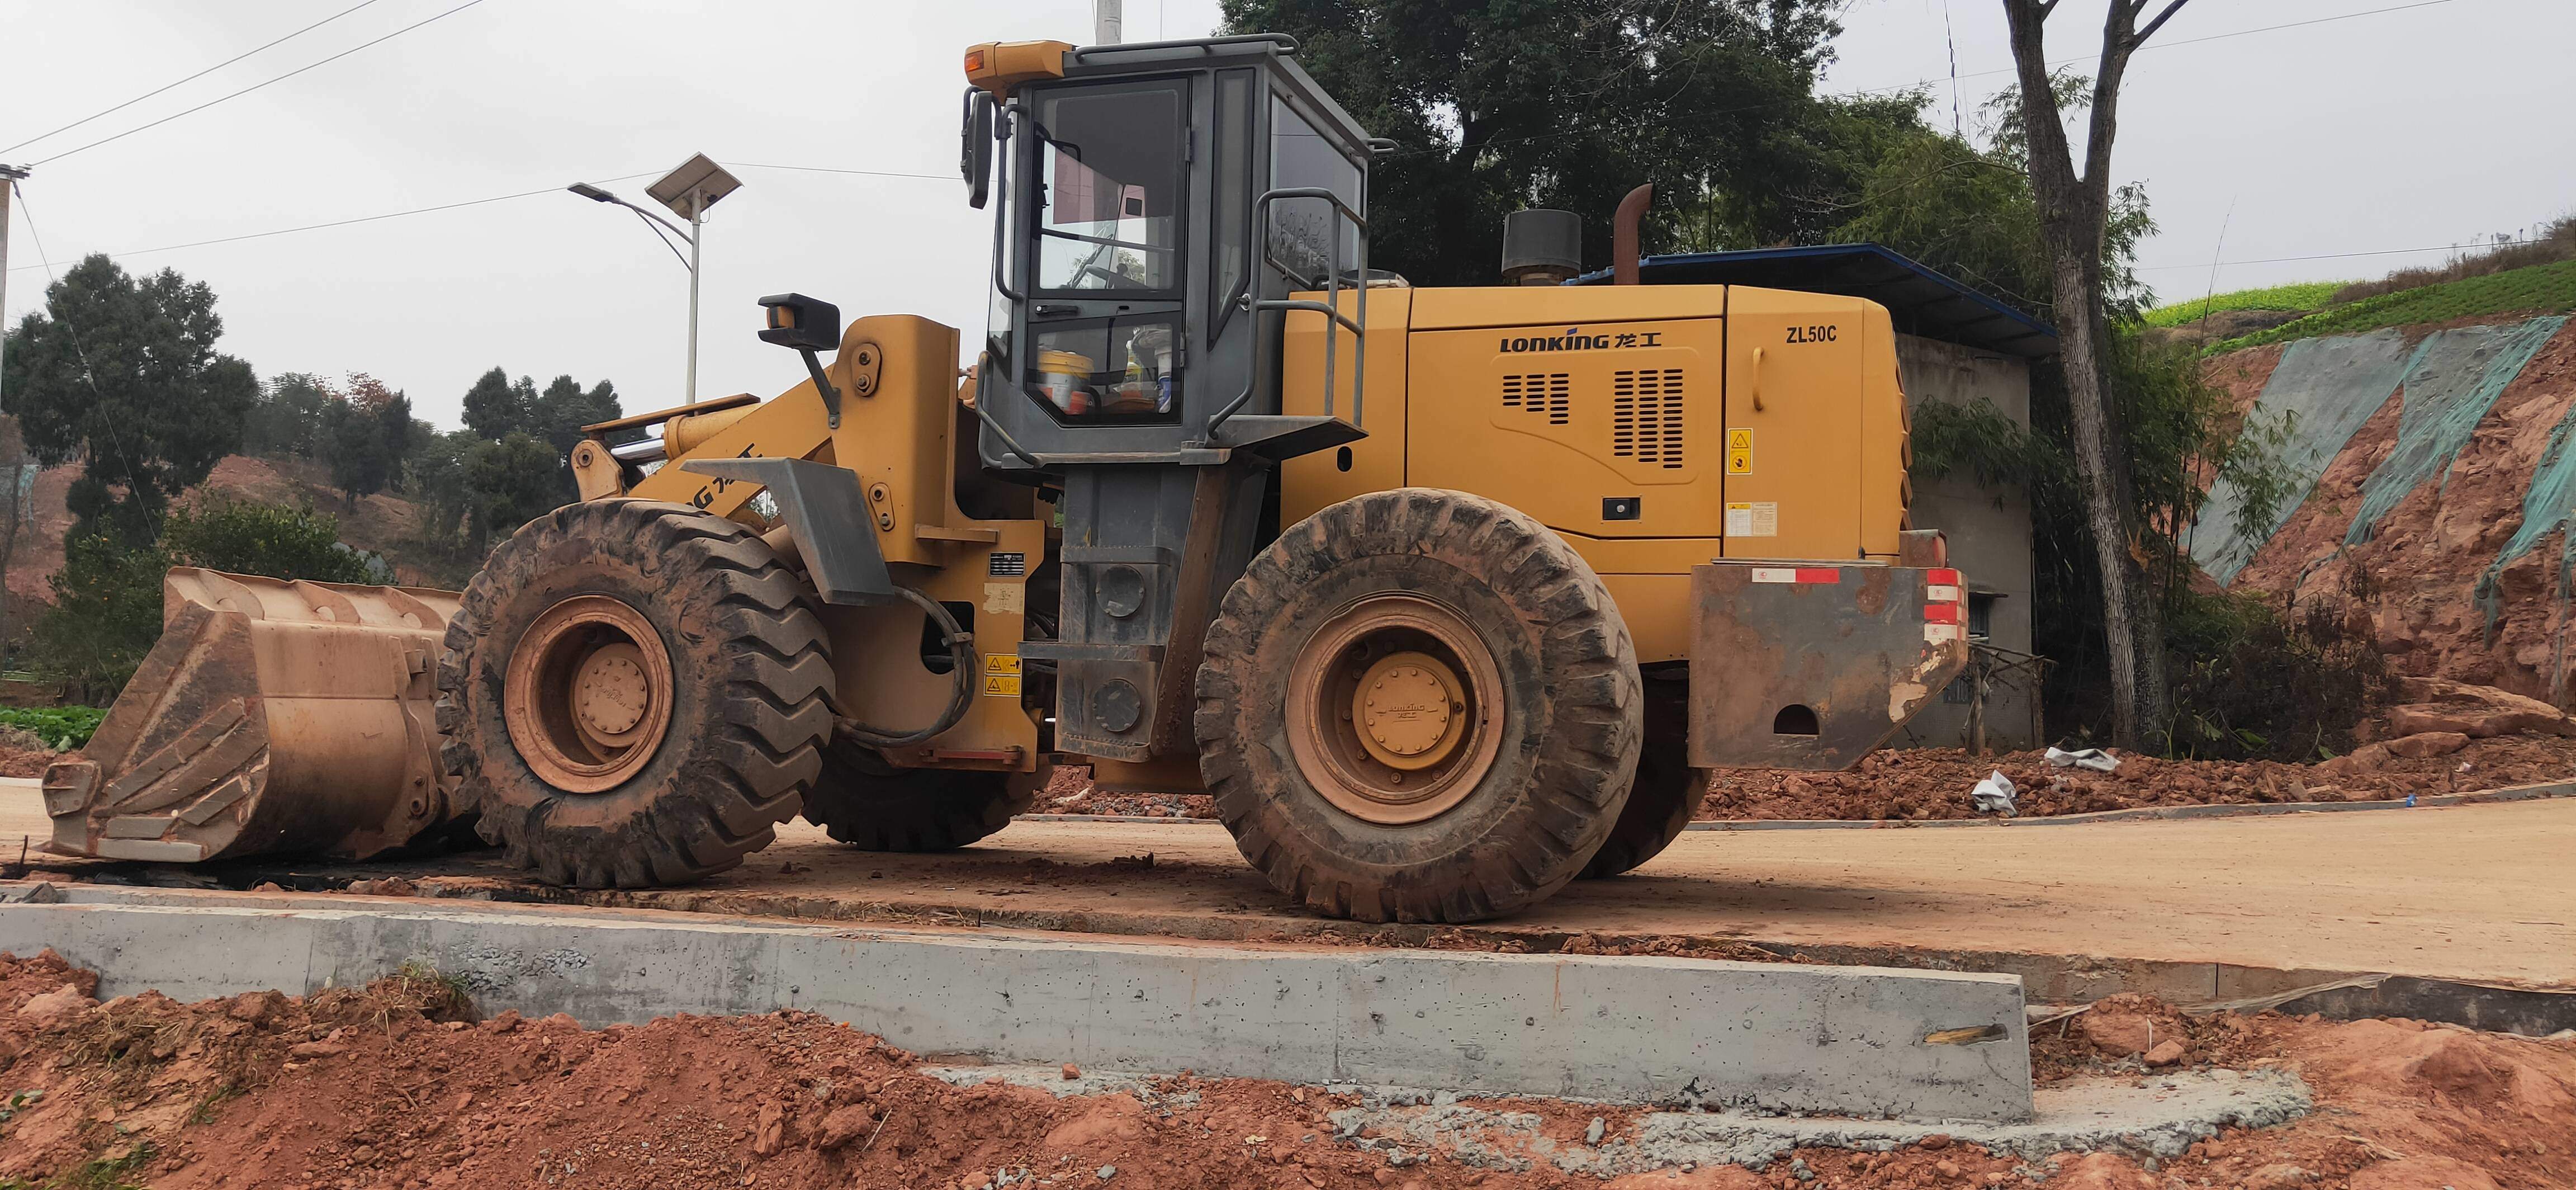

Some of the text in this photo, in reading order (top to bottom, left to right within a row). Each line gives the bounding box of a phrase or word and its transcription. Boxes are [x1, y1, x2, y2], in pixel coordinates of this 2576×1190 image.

[1614, 332, 1661, 348] 龙工
[1786, 325, 1837, 343] ZL50C
[685, 485, 714, 509] G
